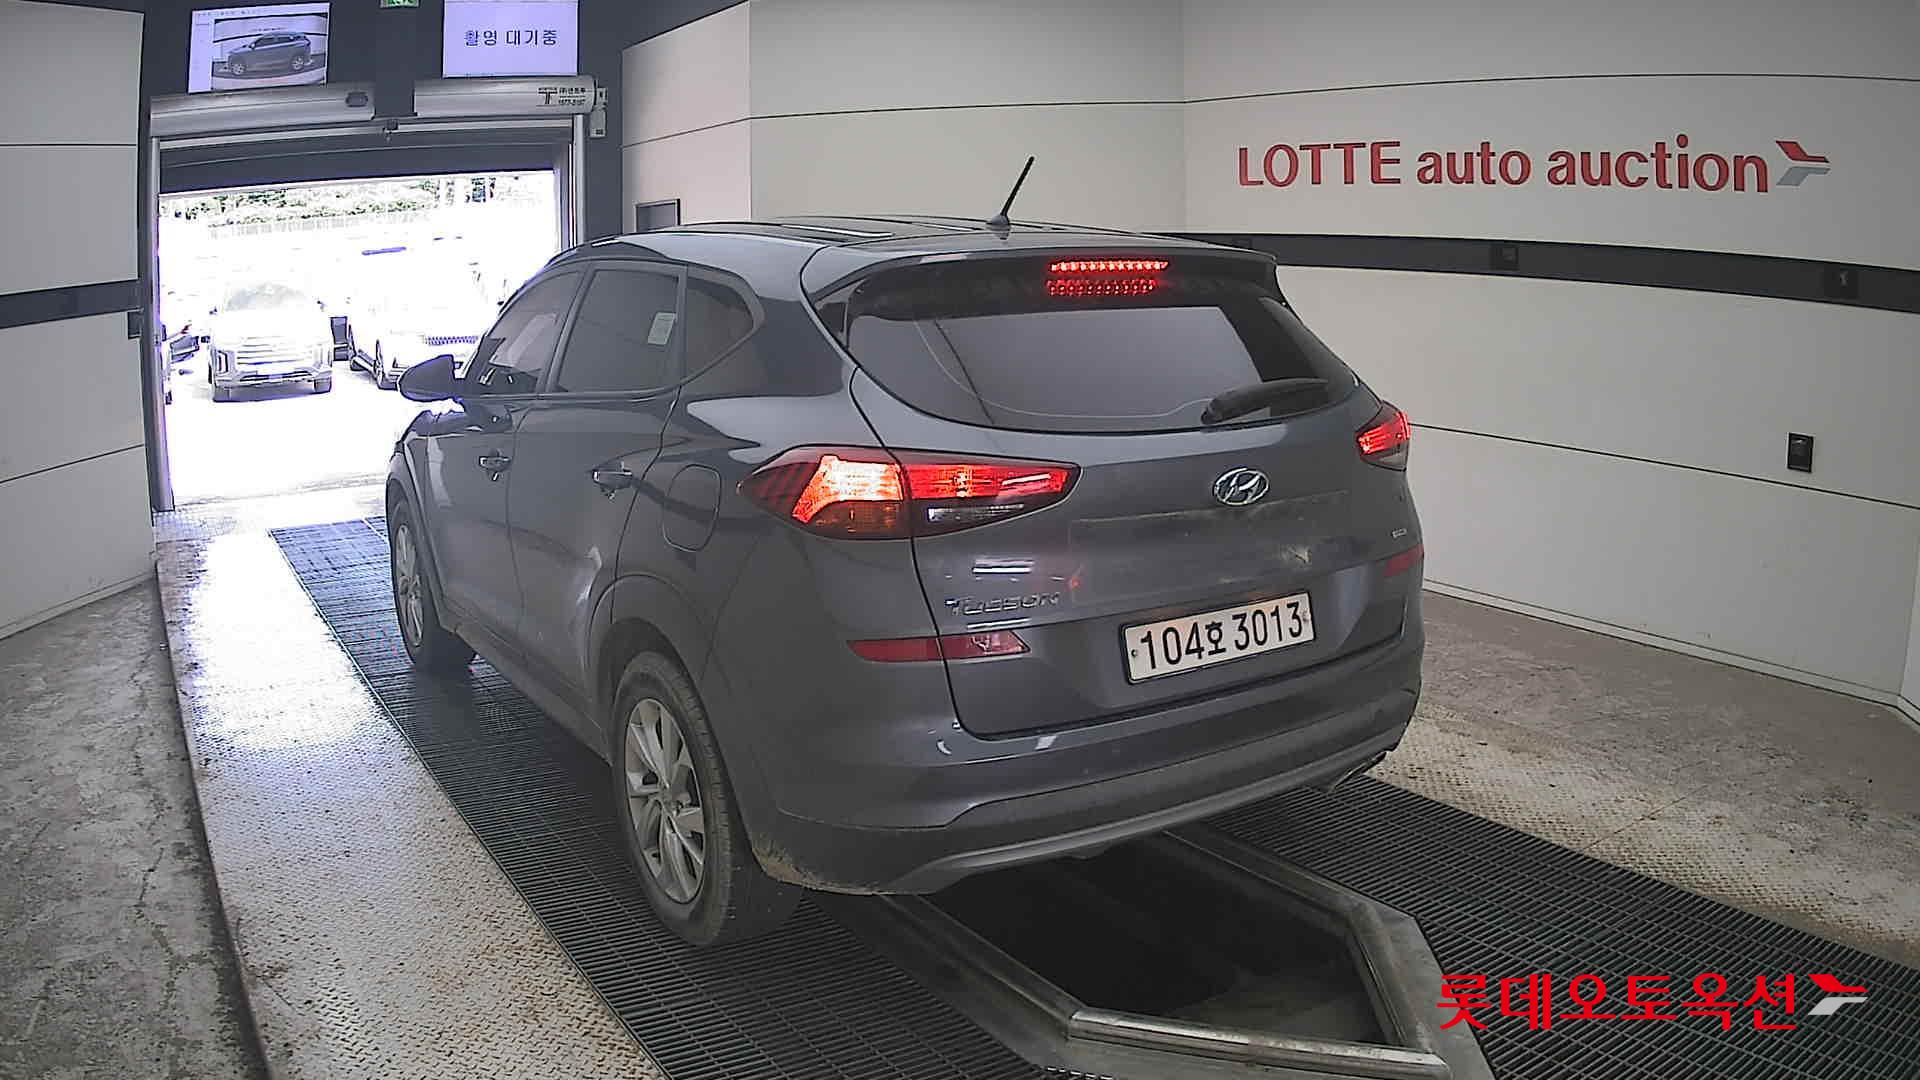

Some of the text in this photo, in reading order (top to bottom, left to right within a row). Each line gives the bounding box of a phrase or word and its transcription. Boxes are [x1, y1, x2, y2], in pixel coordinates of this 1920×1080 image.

[506, 30, 557, 46] 대기중
[1238, 135, 1769, 193] LOTTE auto auction
[1140, 601, 1302, 669] 104호 3013
